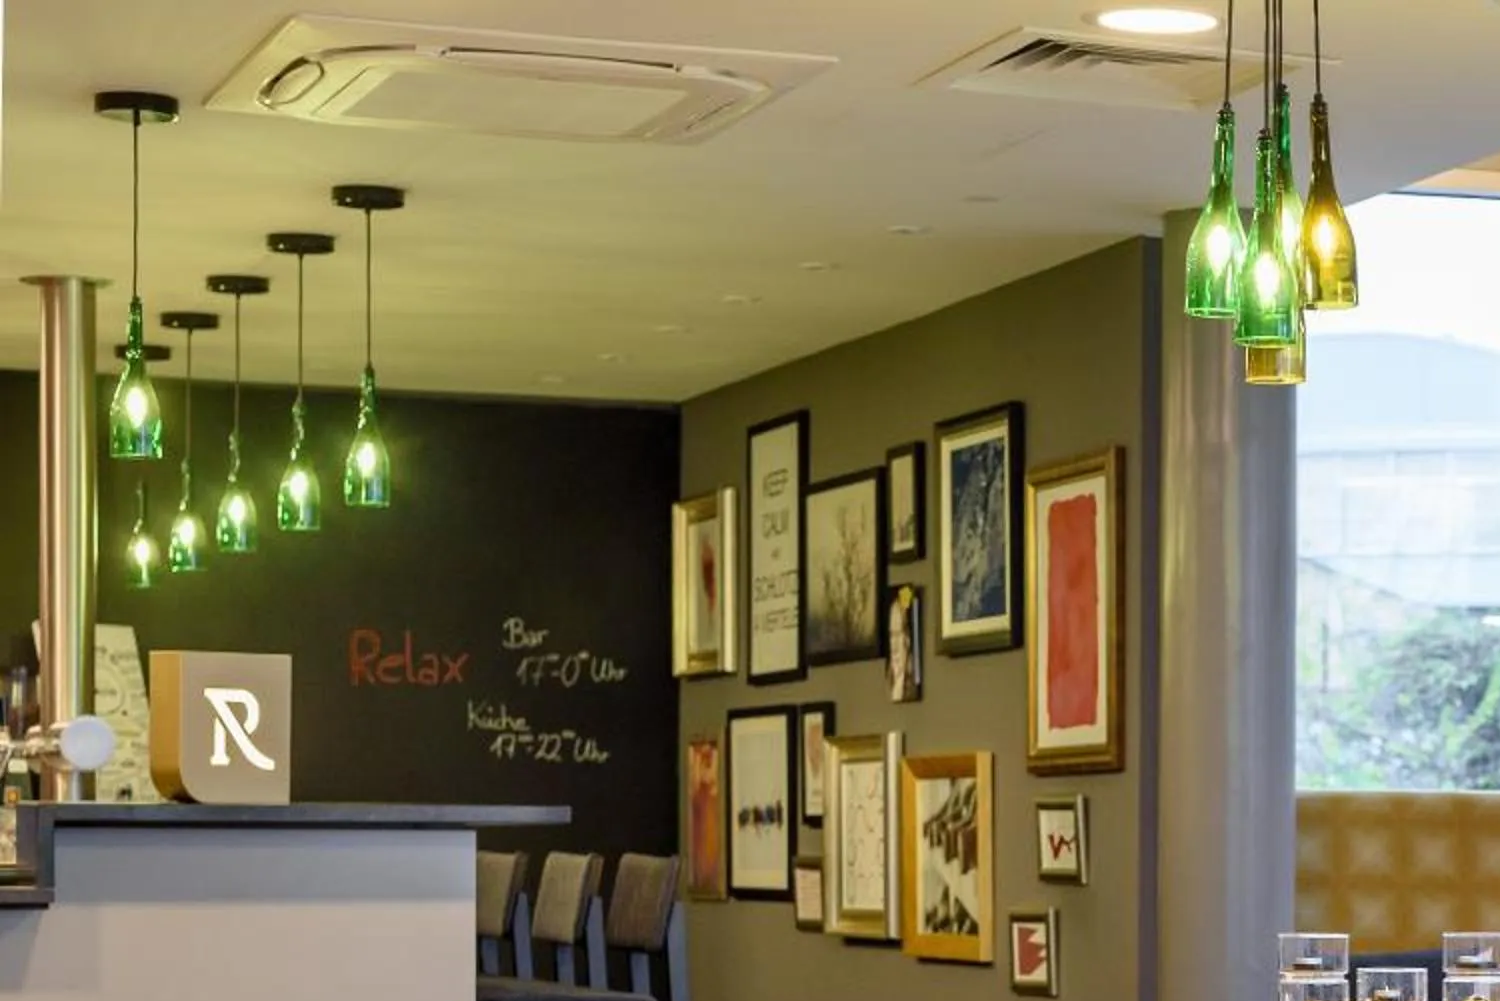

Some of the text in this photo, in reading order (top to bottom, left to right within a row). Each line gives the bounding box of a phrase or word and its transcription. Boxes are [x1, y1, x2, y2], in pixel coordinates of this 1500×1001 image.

[502, 617, 550, 649] Bar
[349, 628, 470, 687] Relax
[590, 656, 628, 683] Uhr
[203, 687, 276, 771] R
[467, 700, 531, 732] Küche
[573, 737, 610, 763] Uhr
